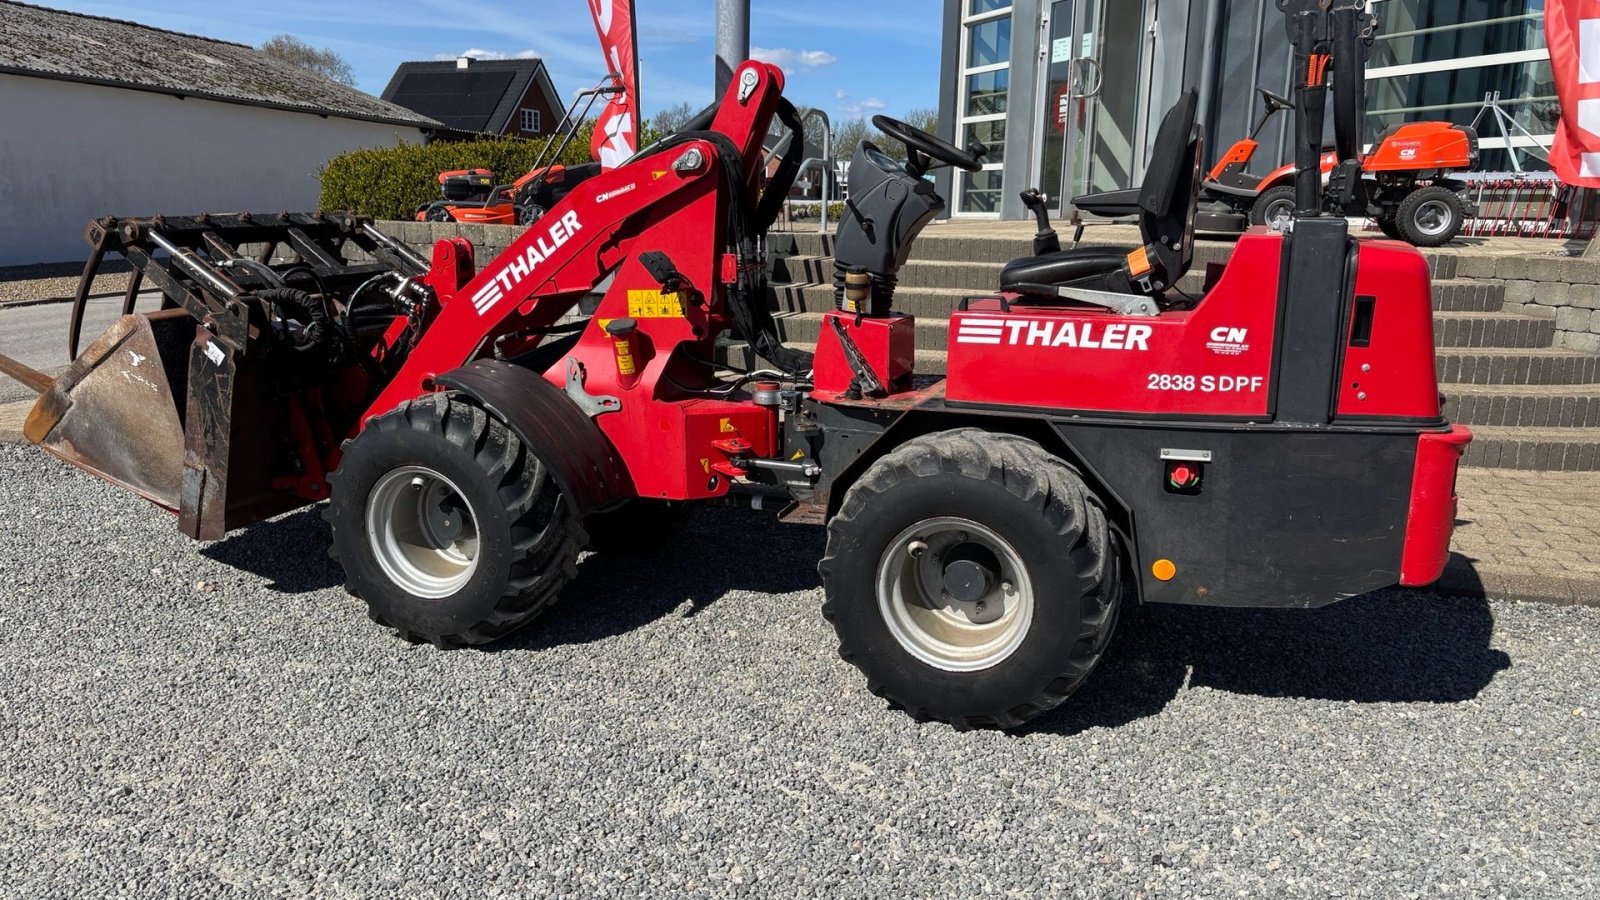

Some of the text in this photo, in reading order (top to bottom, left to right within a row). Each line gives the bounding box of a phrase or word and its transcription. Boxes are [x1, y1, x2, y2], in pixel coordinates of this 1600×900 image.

[595, 192, 609, 203] CN
[496, 210, 582, 291] THALER
[1005, 319, 1153, 351] THALER
[1210, 326, 1248, 343] CN
[1147, 373, 1195, 391] 2838
